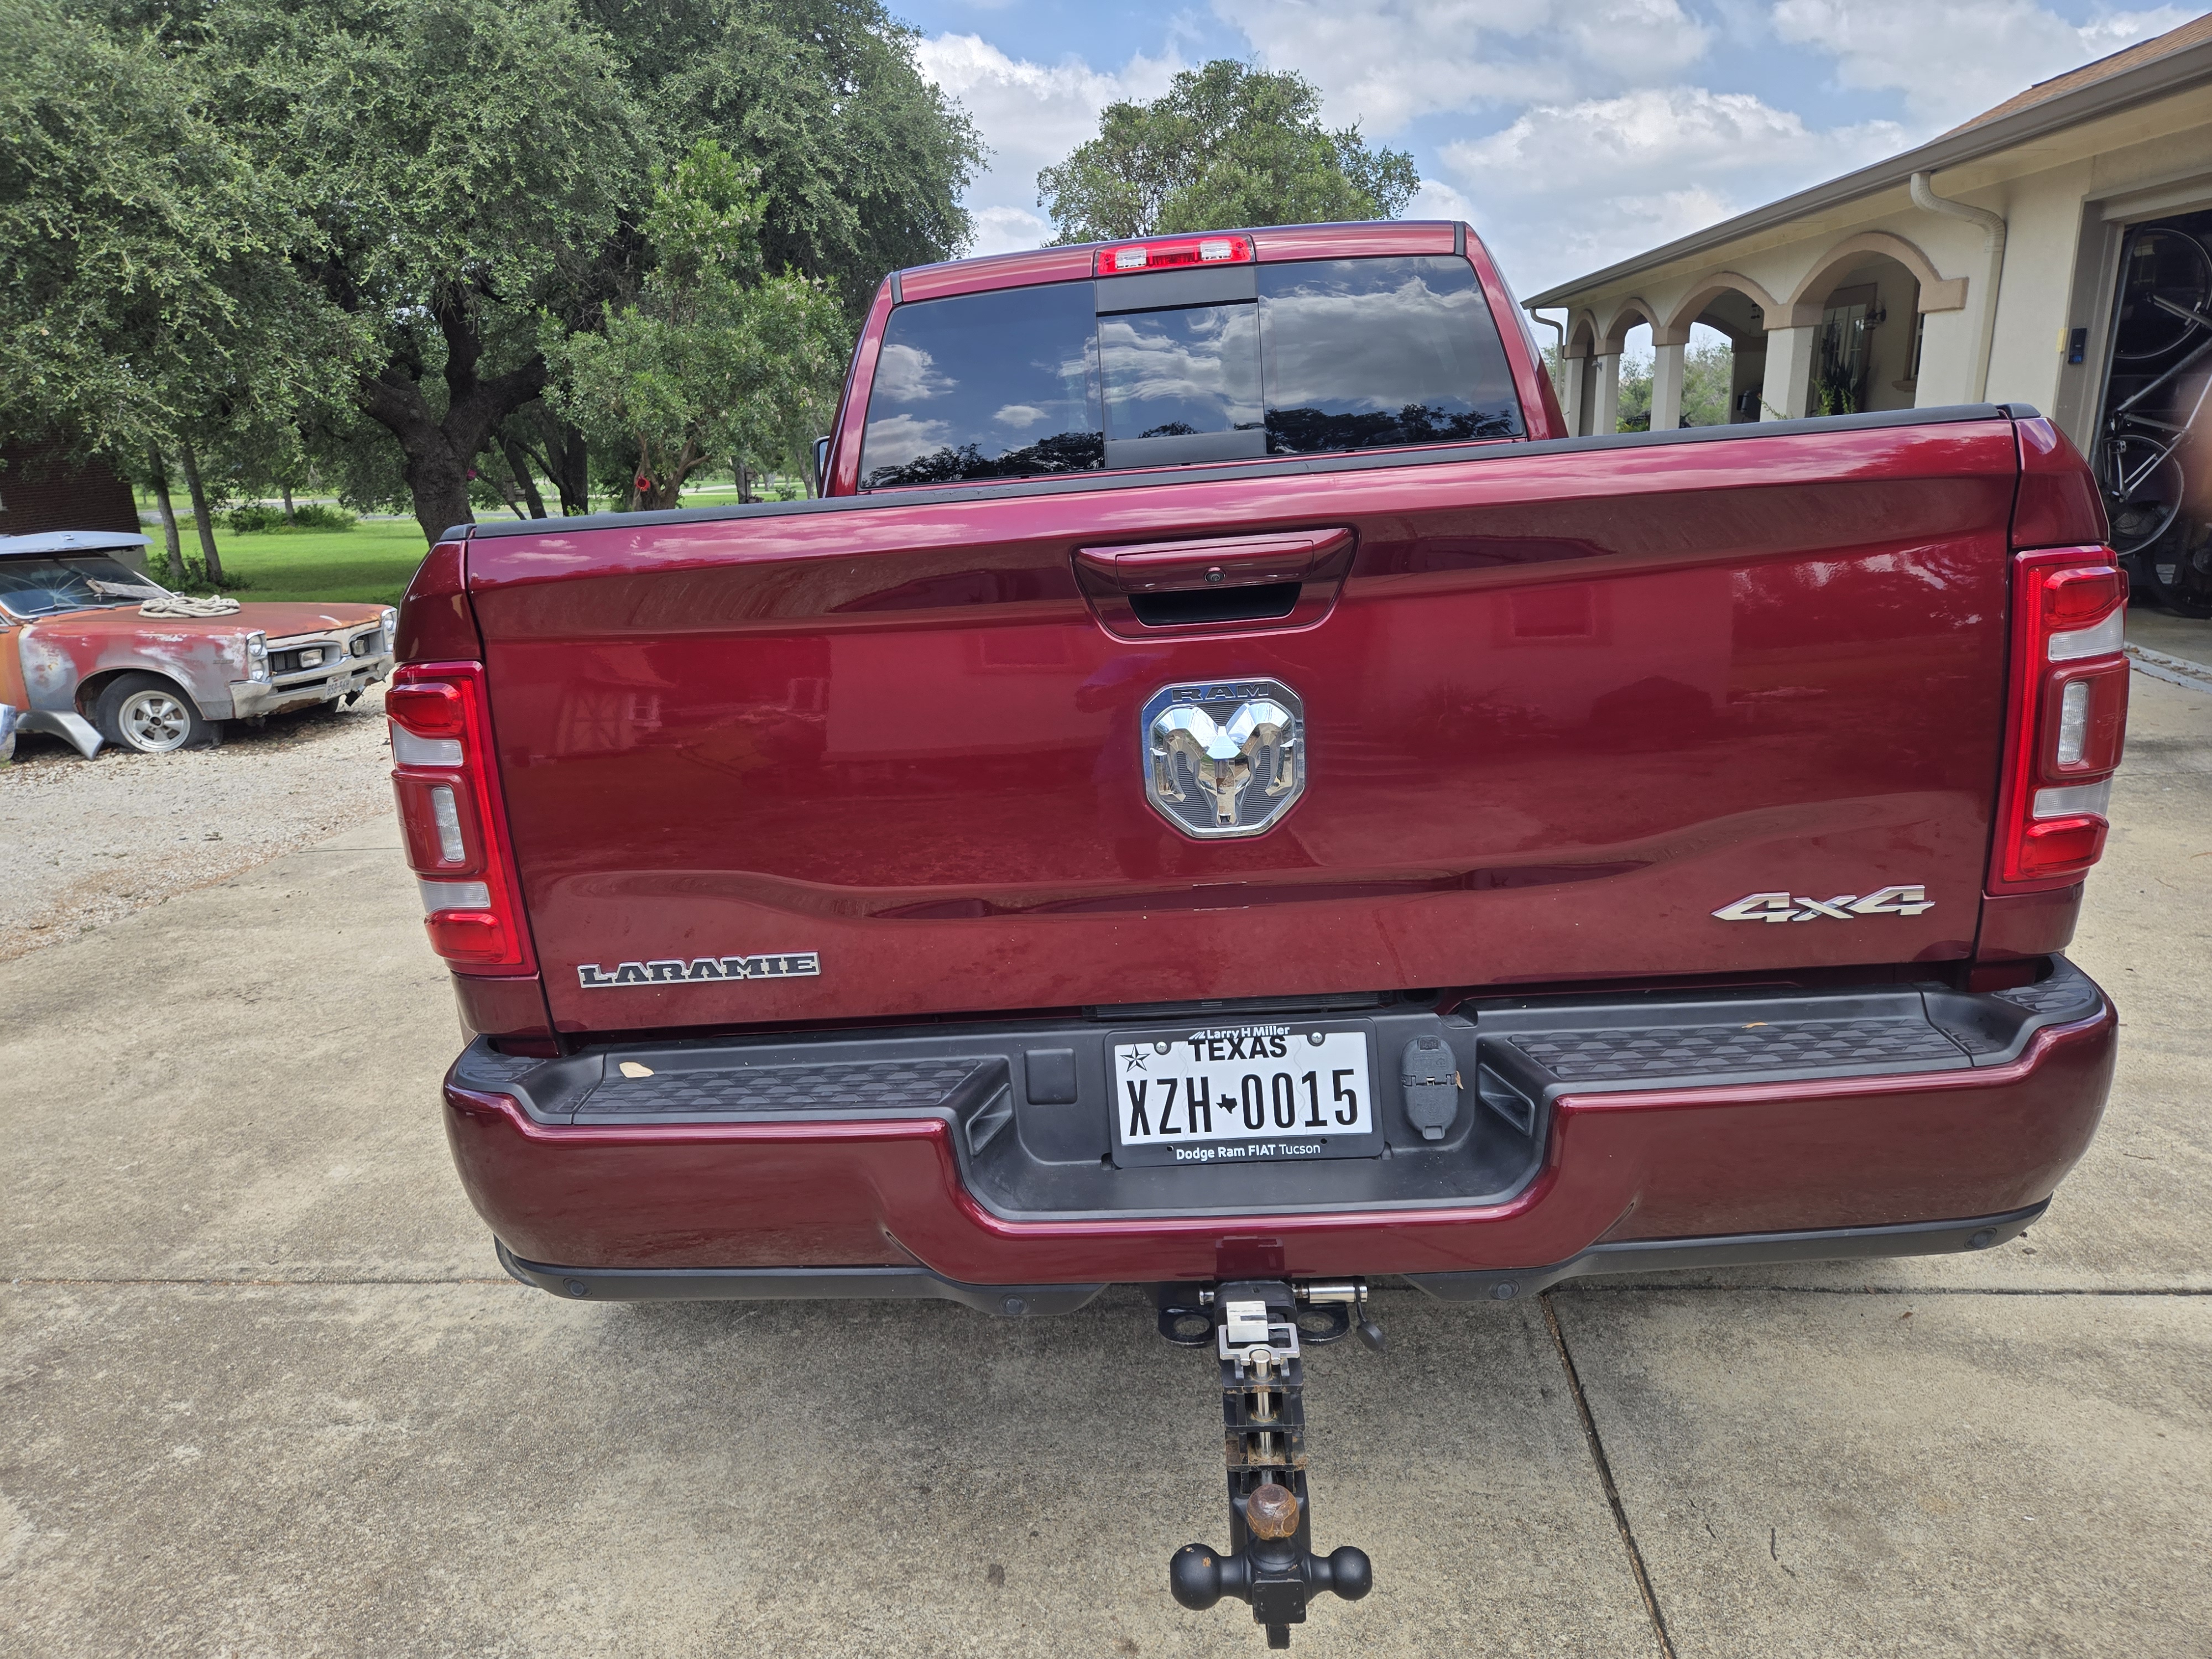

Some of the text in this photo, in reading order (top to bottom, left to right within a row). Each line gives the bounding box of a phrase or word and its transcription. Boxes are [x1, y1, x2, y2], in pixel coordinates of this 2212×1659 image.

[1171, 683, 1269, 702] RAM
[577, 950, 821, 988] LARAMIE
[1207, 1025, 1290, 1040] Larry H Miller
[1187, 1035, 1287, 1062] TEXAS
[1126, 1068, 1358, 1136] XZH 0015
[1176, 1144, 1321, 1162] Dodge Ram FIAT Tucson
